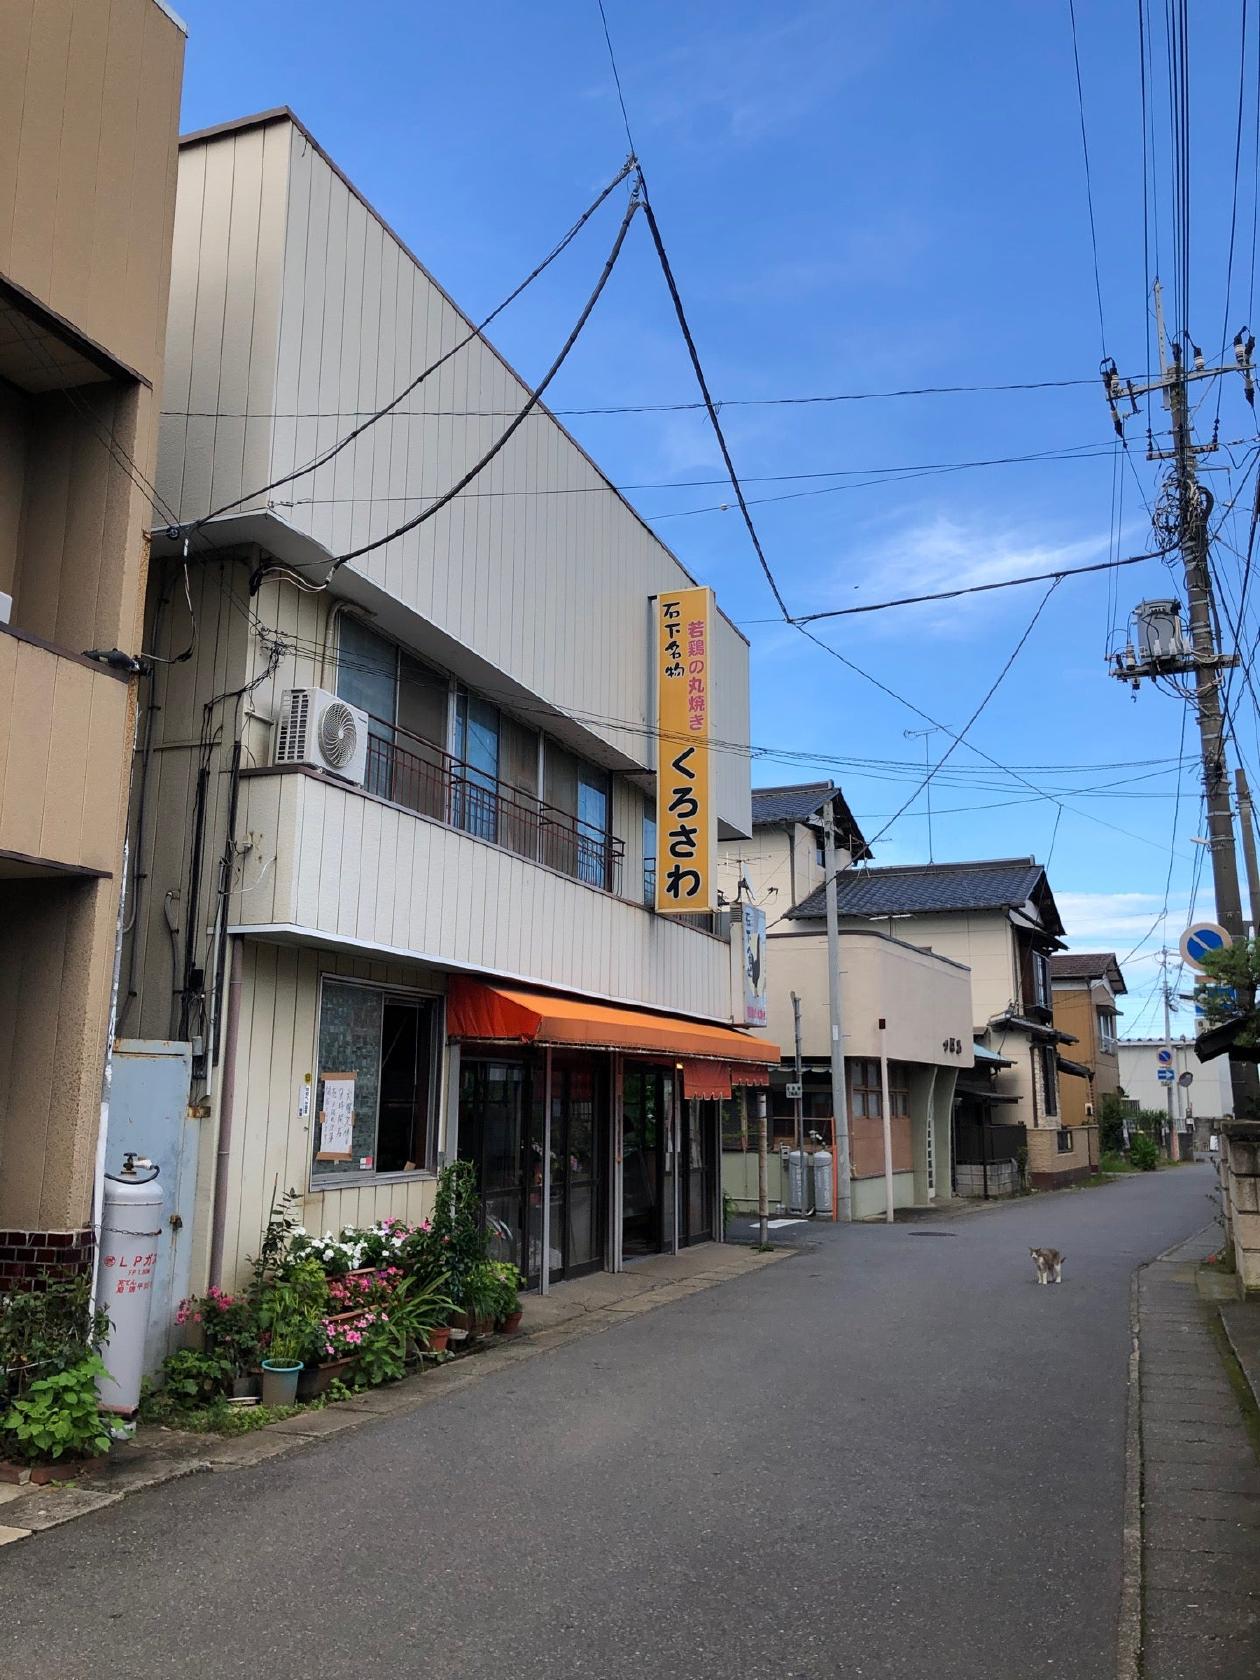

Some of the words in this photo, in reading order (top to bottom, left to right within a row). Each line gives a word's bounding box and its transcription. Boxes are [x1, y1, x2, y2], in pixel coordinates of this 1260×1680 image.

[662, 601, 685, 678] 石下名物
[688, 620, 705, 731] 若鶏の丸焼き
[666, 746, 701, 899] くろさわ
